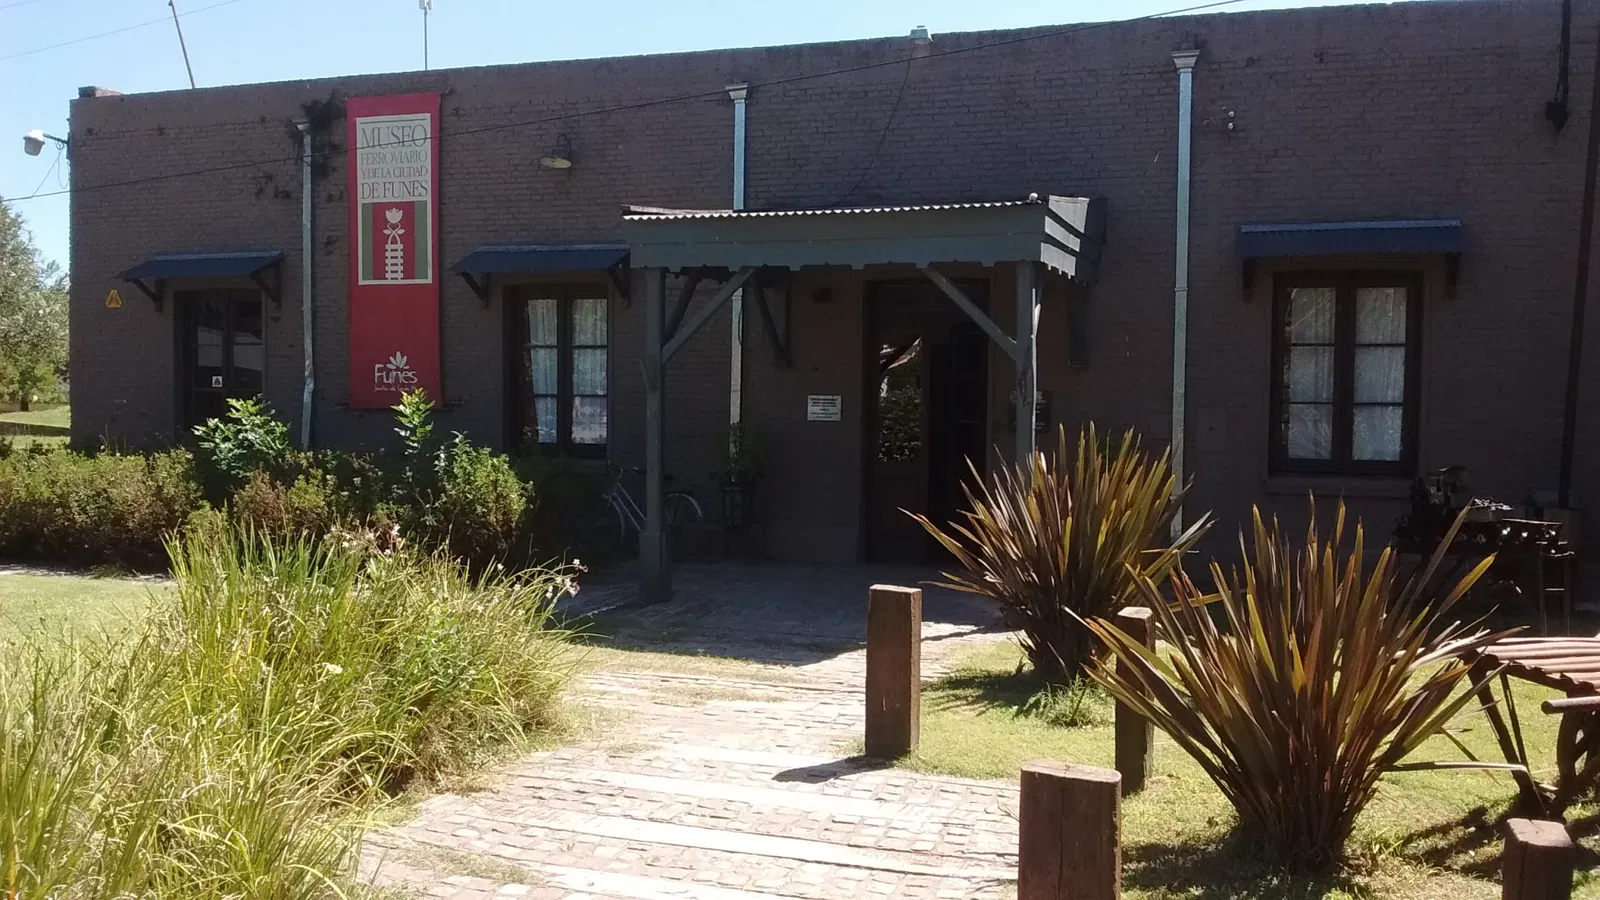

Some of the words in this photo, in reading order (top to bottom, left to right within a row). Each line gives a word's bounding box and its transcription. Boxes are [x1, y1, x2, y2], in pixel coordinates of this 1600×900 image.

[361, 124, 427, 149] MUSEO
[360, 150, 428, 165] FERROVIARIO
[393, 165, 429, 178] CIUDAD
[361, 182, 380, 200] DE
[382, 180, 428, 199] FUNES
[374, 363, 418, 384] Funes
